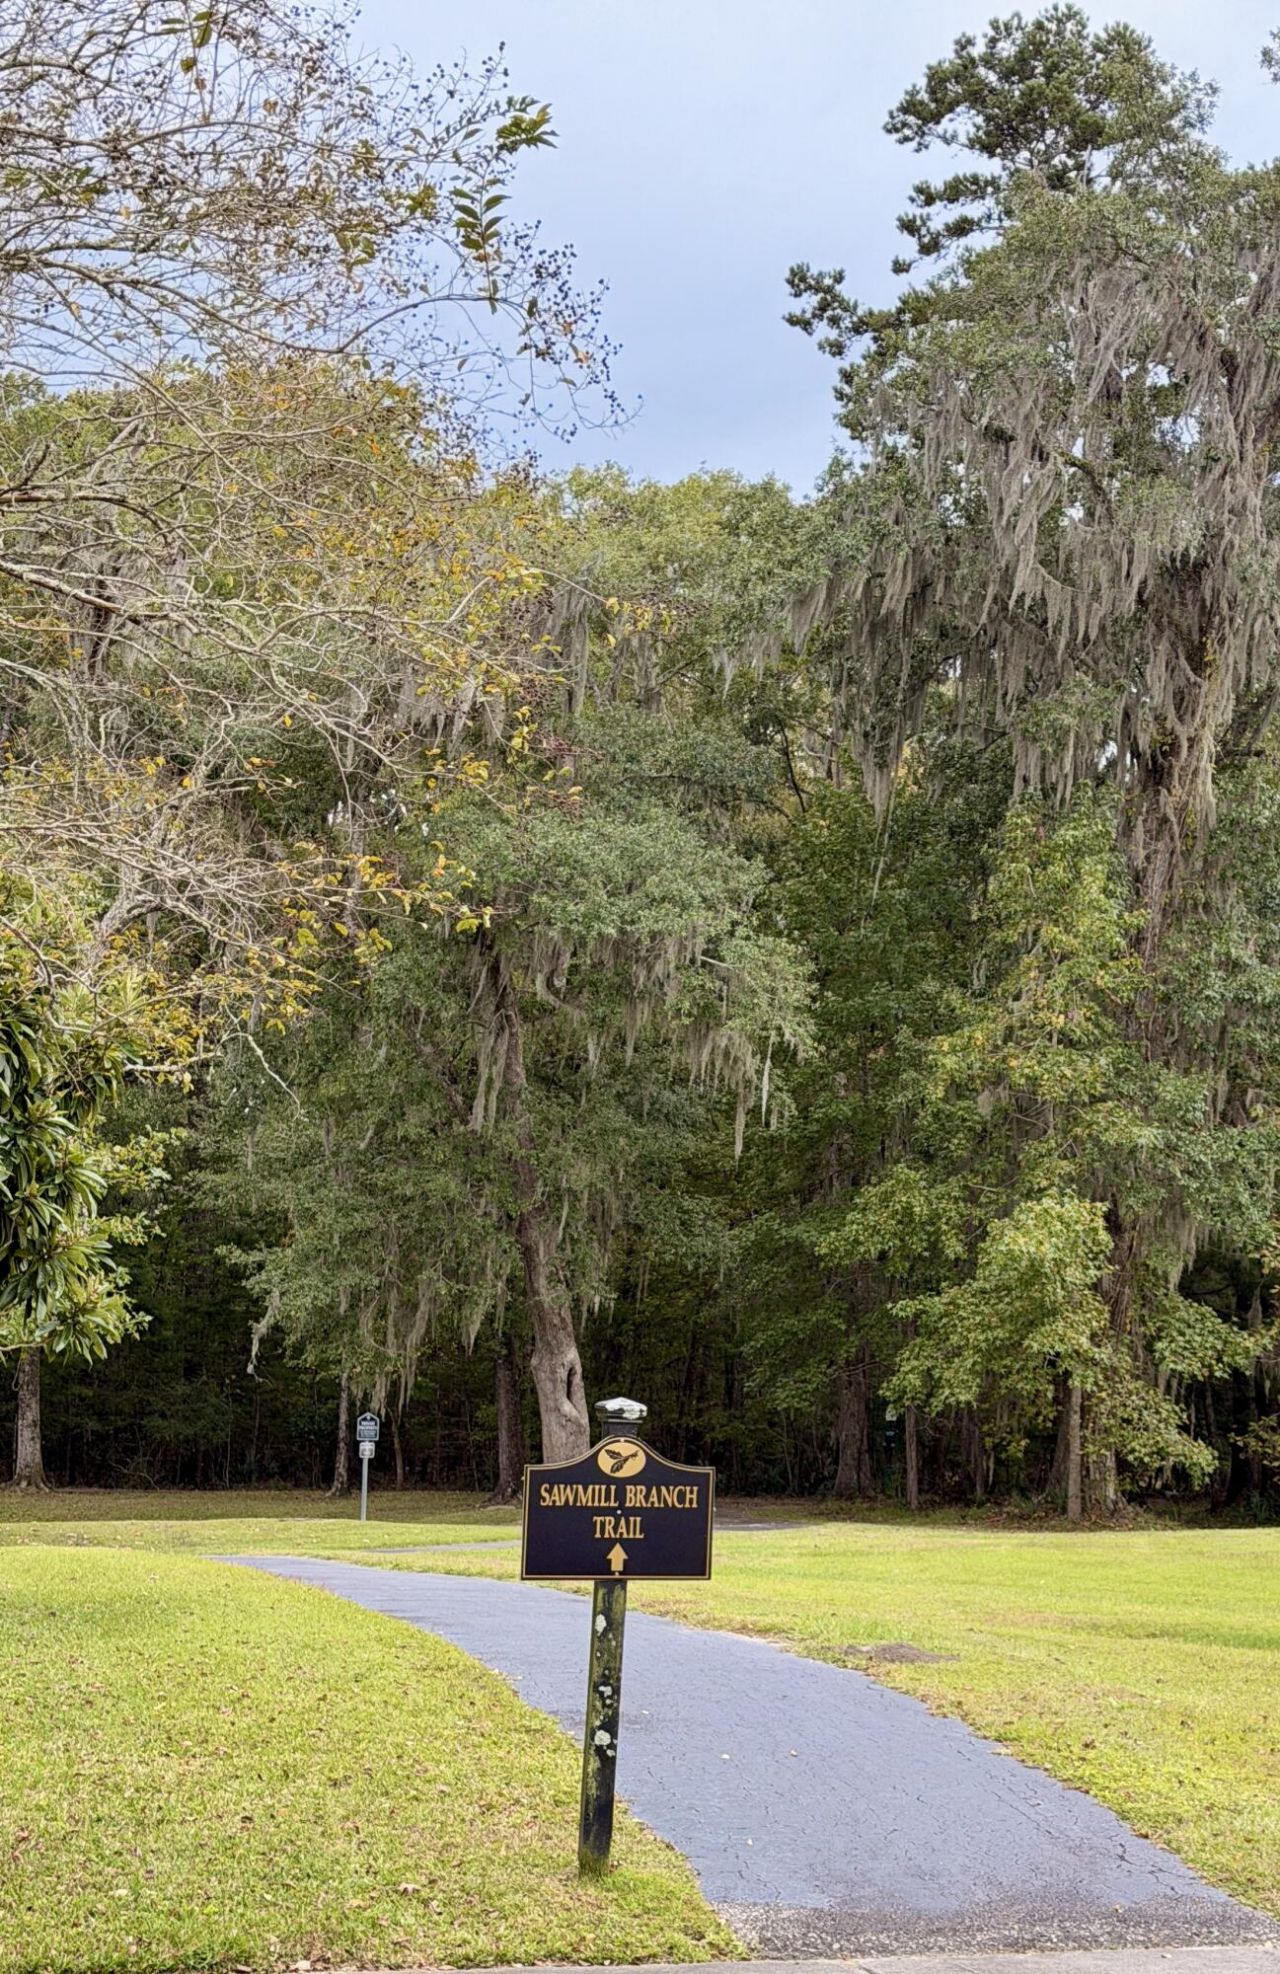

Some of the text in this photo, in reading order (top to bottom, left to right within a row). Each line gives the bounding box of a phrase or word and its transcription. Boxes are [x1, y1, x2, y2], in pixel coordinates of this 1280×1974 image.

[540, 1483, 699, 1508] SAWMILL BRANCH
[593, 1516, 644, 1539] TRAIL
